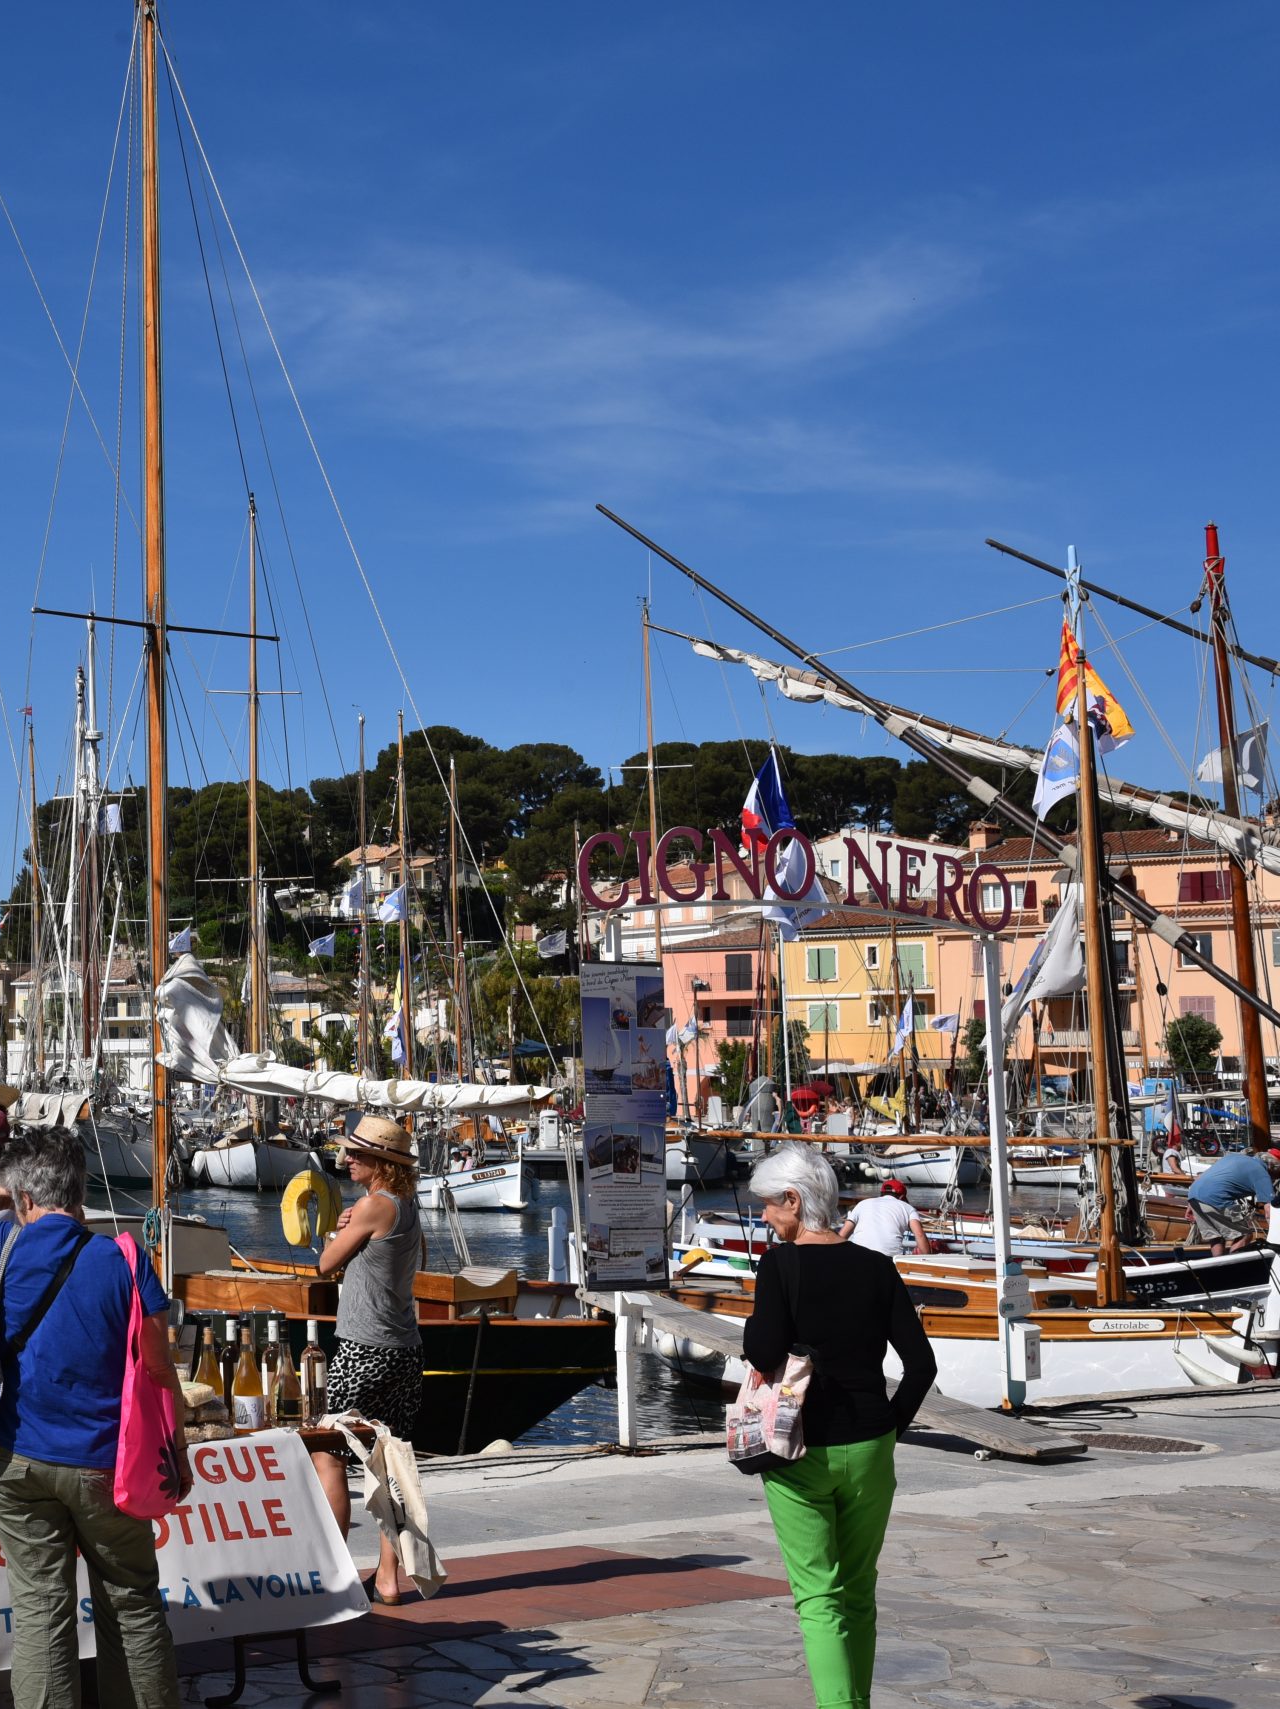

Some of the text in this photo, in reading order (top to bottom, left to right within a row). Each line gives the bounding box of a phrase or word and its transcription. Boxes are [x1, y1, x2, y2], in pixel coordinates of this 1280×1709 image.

[577, 827, 1012, 933] CIGNO NERO
[1102, 1321, 1150, 1330] Astrolabe
[182, 1570, 326, 1608] À LA VOILE
